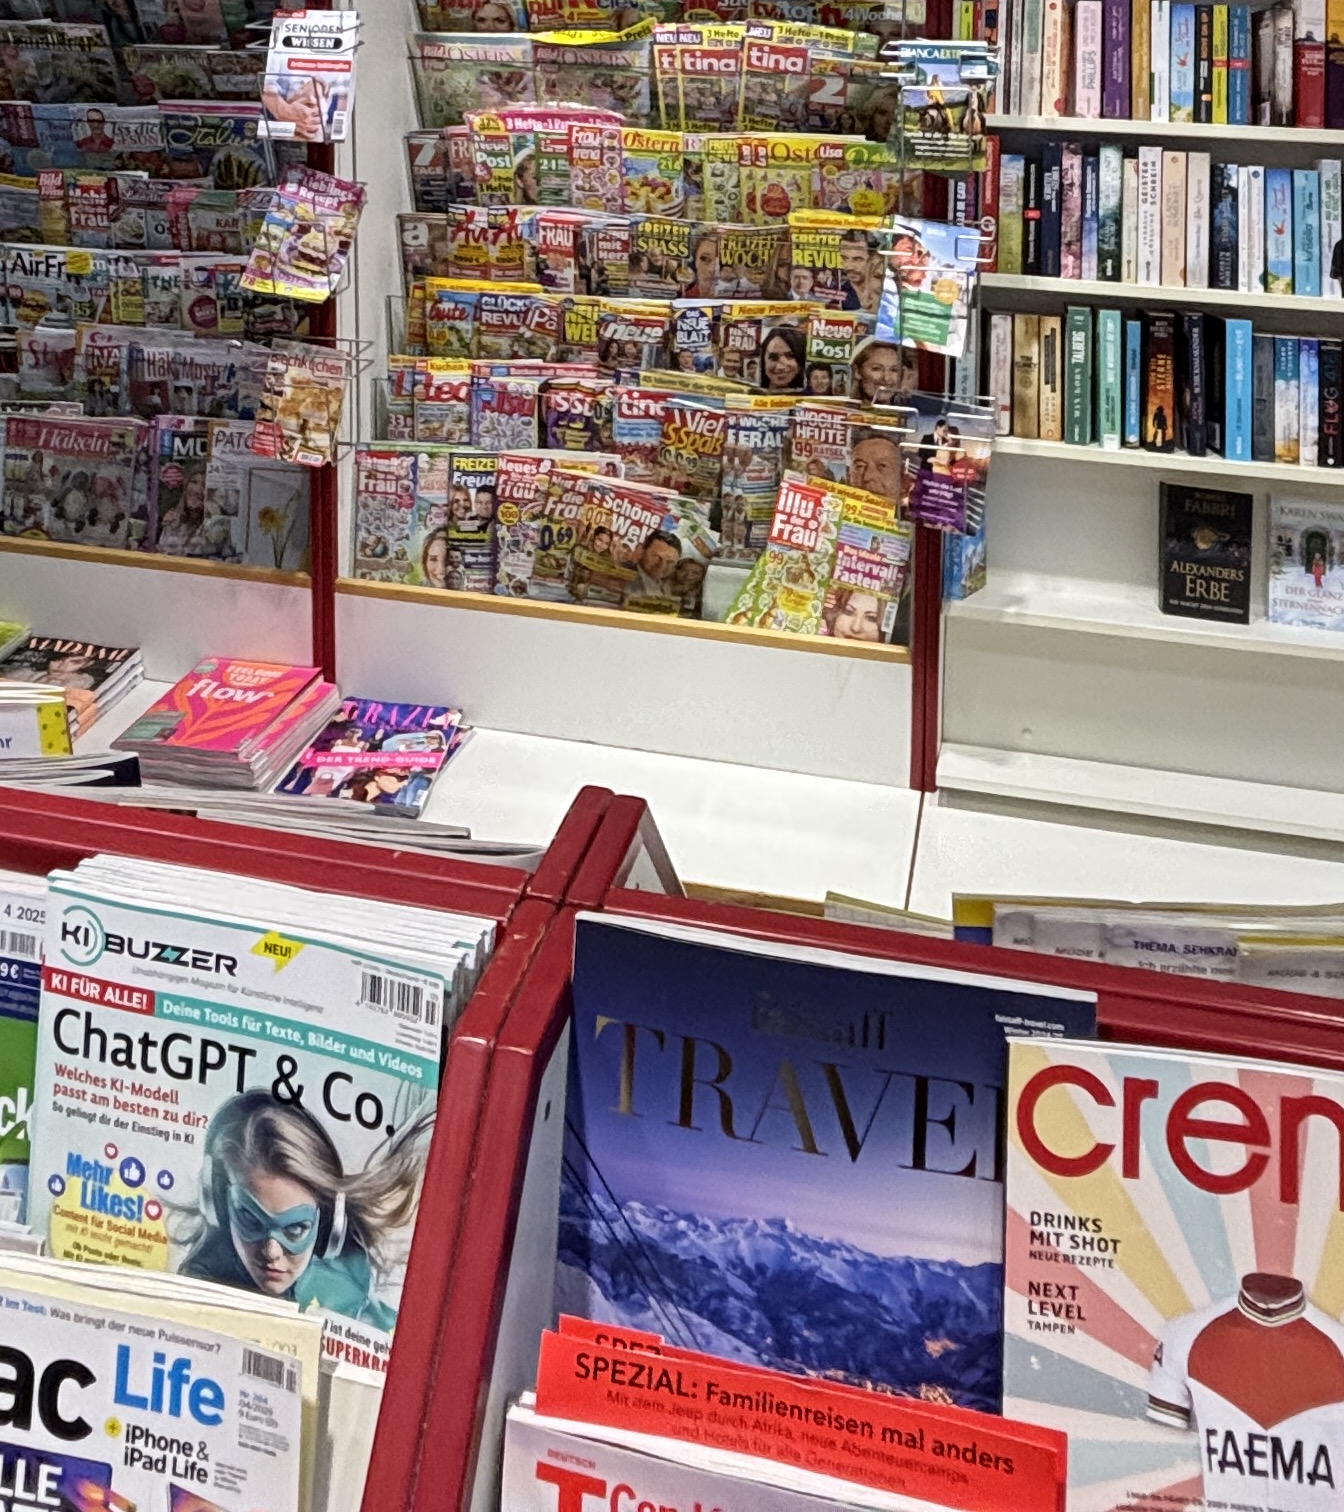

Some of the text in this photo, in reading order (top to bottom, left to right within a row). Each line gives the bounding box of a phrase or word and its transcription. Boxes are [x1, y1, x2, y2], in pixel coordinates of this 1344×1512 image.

[683, 50, 736, 72] tina
[750, 47, 804, 72] tina
[812, 340, 851, 358] Post
[777, 483, 814, 518] illu
[1280, 505, 1317, 519] KAREN
[772, 515, 818, 550] Frau
[1170, 560, 1244, 581] ALEXANDERS
[1185, 575, 1230, 602] ERBE
[185, 678, 275, 707] flow
[264, 941, 292, 960] NEU!
[51, 975, 67, 991] KI
[70, 978, 102, 999] FÜR
[104, 986, 148, 1010] ALLE!
[162, 999, 423, 1078] Deine Tools für Texte, Bilder und Videos
[54, 1008, 396, 1138] ChatGPT & Co.
[54, 1063, 179, 1105] Welches KI-Modell
[53, 1083, 208, 1130] passt am besten zu dir?
[67, 1151, 114, 1183] Mehr
[80, 1182, 144, 1223] Likes!
[1029, 1210, 1104, 1234] DRINKS
[1029, 1230, 1121, 1255] MIT SHOT
[1028, 1281, 1080, 1301] NEXT
[1027, 1299, 1086, 1321] LEVEL
[1027, 1319, 1077, 1336] TAMPEN
[113, 1344, 225, 1428] Life
[574, 1352, 699, 1401] SPEZIAL:
[704, 1383, 874, 1439] Familienreisen
[879, 1423, 925, 1452] mal
[931, 1438, 1016, 1476] anders
[124, 1423, 210, 1462] iPhone &
[1205, 1427, 1336, 1489] FAEMA
[123, 1447, 209, 1486] iPad Life
